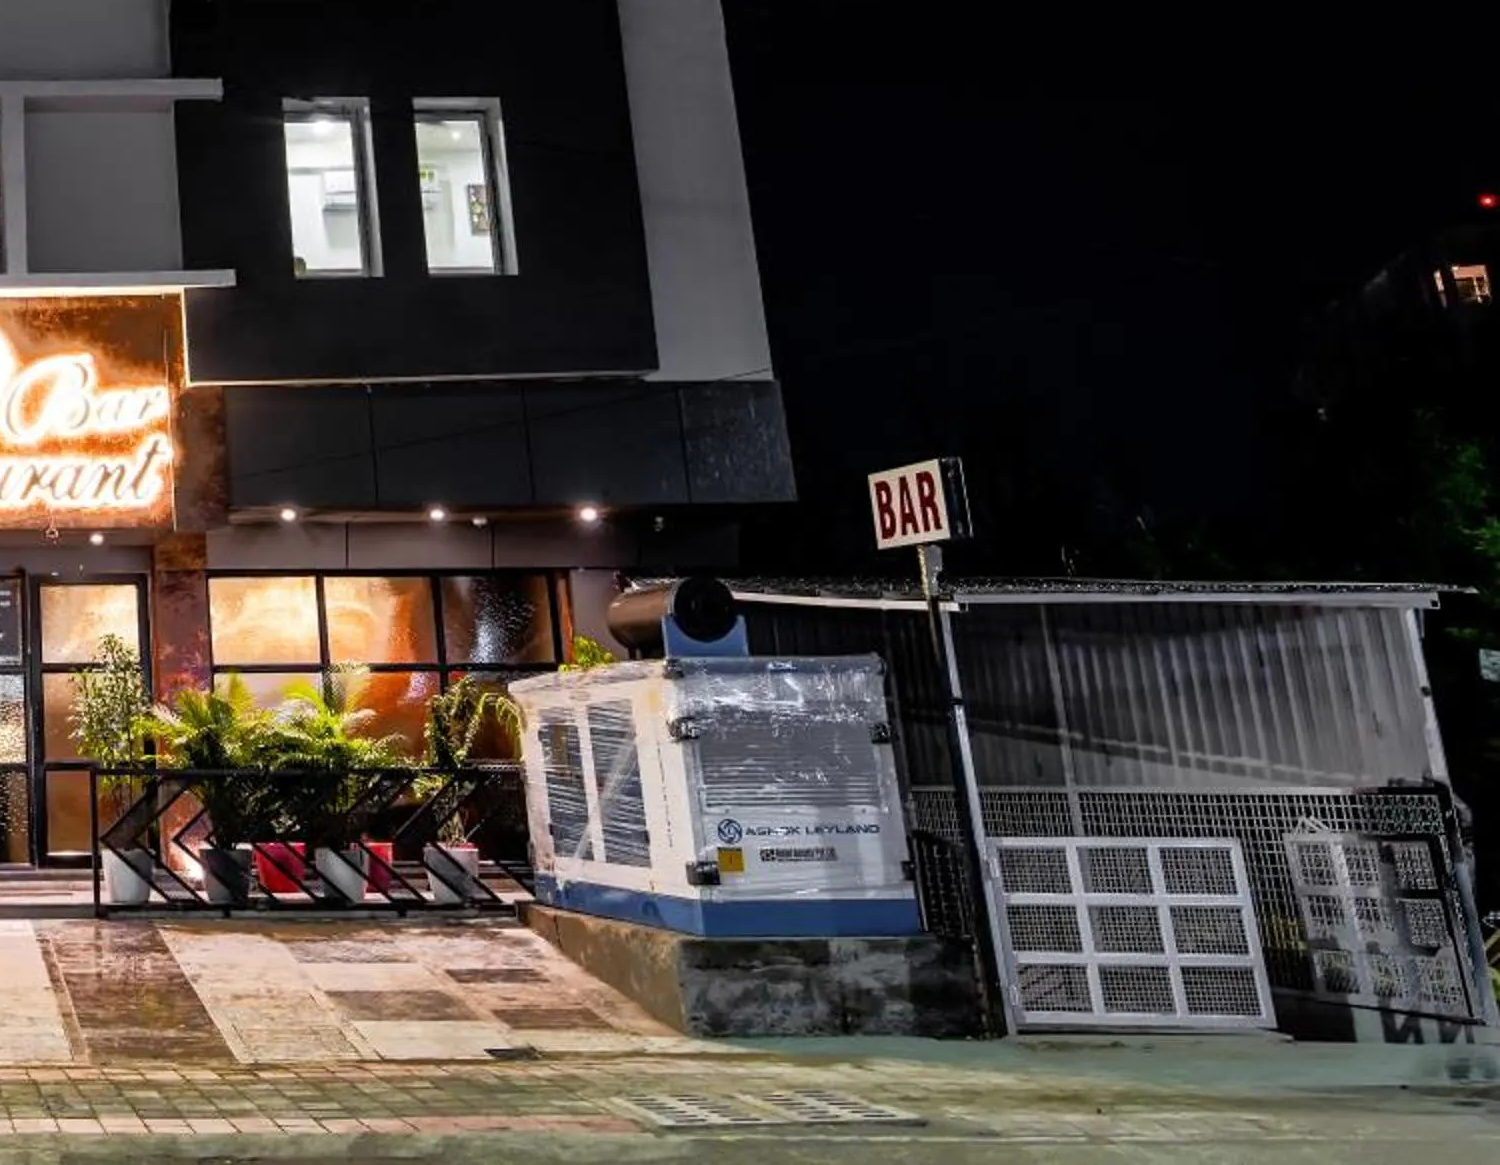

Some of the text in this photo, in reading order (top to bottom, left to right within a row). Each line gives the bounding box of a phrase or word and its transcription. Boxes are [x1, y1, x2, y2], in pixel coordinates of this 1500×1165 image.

[3, 356, 168, 440] Bar
[874, 470, 943, 540] BAR
[805, 824, 881, 835] LEYLAND
